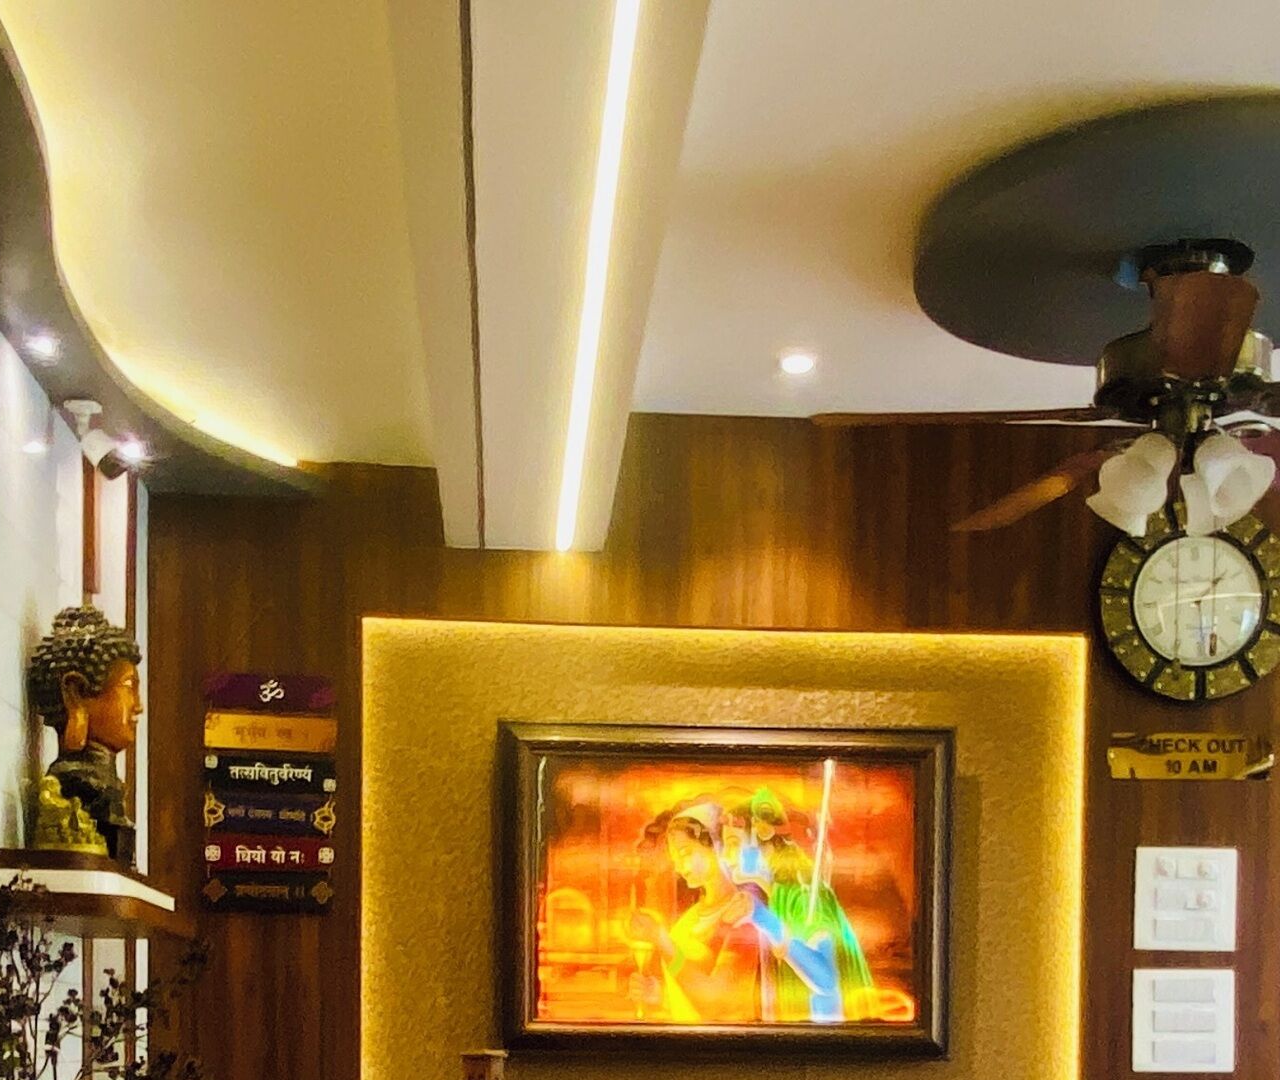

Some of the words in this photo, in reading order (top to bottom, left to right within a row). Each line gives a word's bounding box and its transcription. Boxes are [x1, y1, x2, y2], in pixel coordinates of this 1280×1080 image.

[1207, 738, 1246, 753] OUT
[1189, 758, 1218, 773] AM
[270, 846, 286, 864] यो
